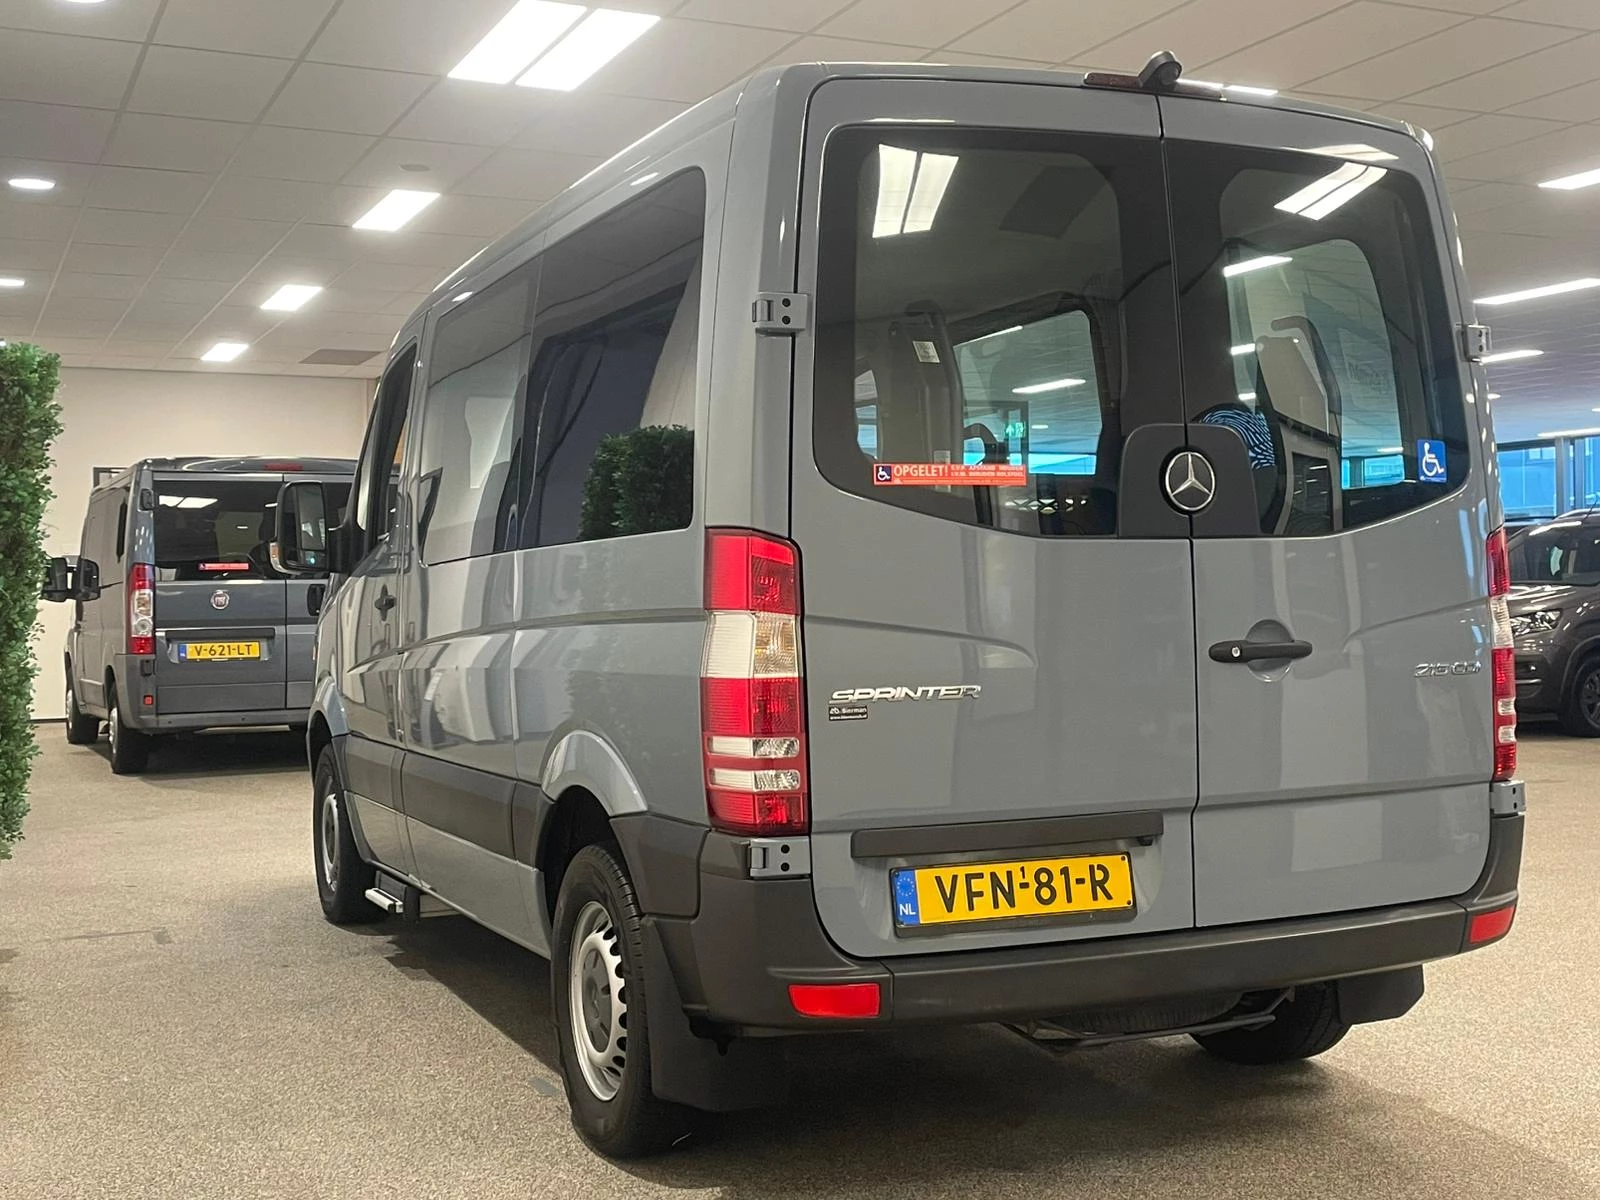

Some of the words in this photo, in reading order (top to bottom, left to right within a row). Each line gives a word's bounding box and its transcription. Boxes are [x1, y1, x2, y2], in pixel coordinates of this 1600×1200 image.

[893, 465, 949, 477] OPGELET!
[194, 644, 253, 656] V-621-LT
[1414, 663, 1449, 677] 215
[829, 684, 982, 705] SPRINTER
[899, 904, 916, 916] NL
